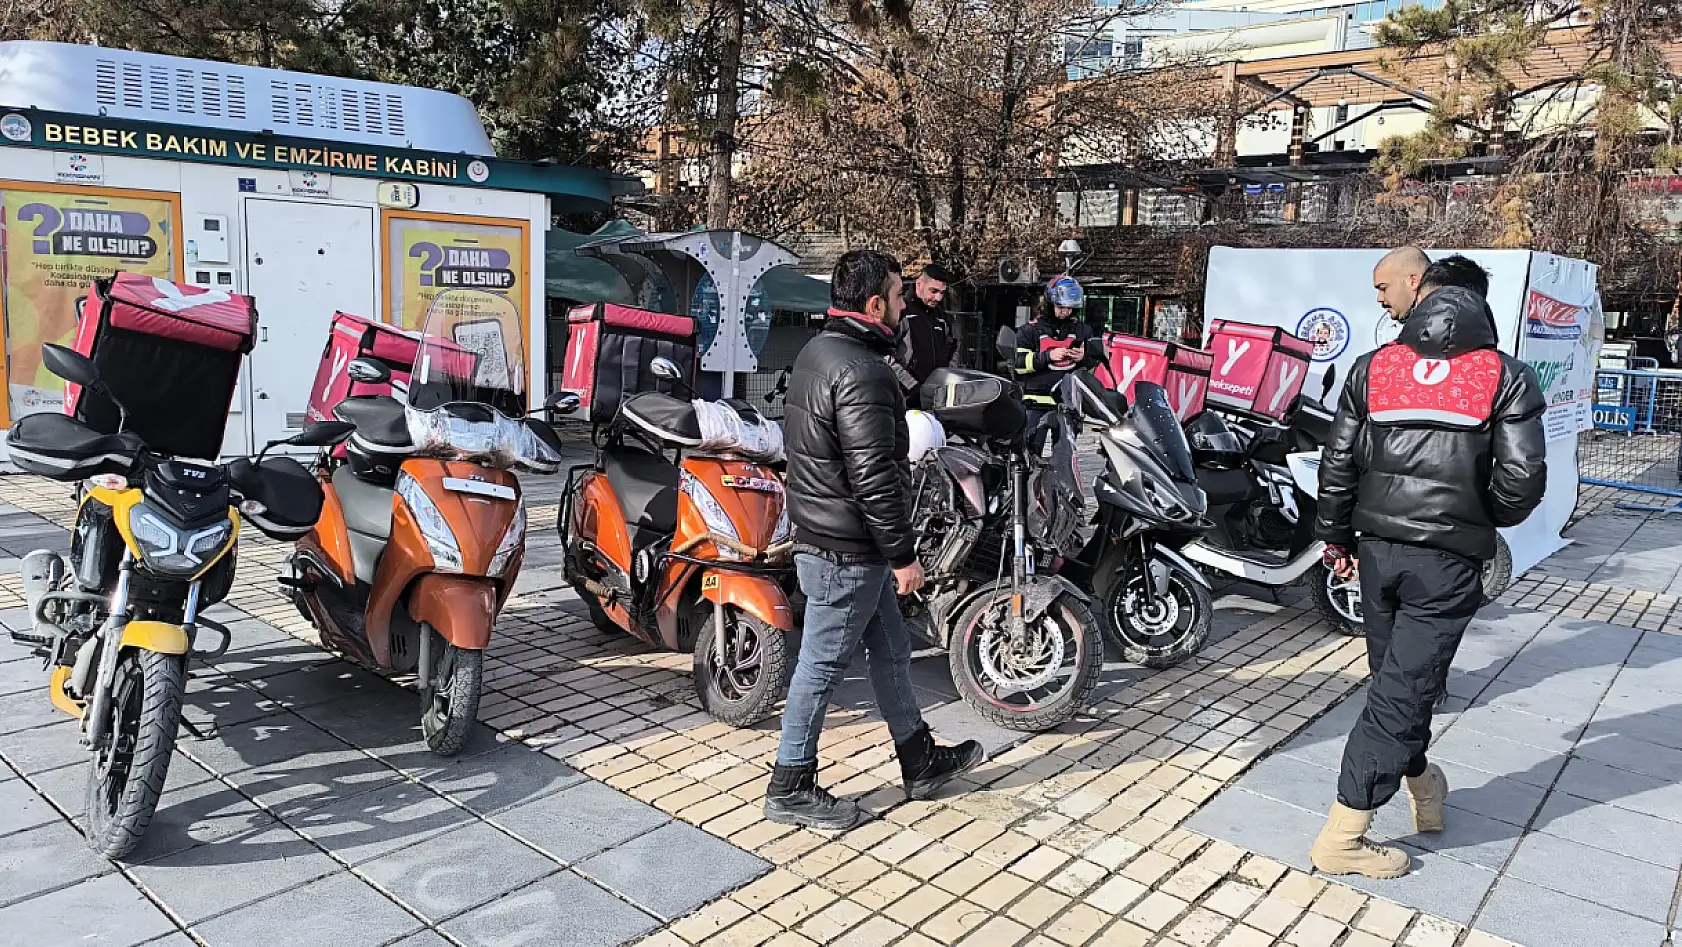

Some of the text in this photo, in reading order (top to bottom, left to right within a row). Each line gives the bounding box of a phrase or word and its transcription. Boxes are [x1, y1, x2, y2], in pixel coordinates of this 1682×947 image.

[45, 123, 138, 149] BEBEK
[146, 133, 228, 157] BAKIM
[235, 141, 267, 161] VE
[274, 146, 378, 172] EMZİRME
[385, 156, 458, 179] KABİNİ
[69, 212, 124, 233] DAHA
[62, 236, 150, 255] NE OLSUN?
[448, 249, 490, 267] DAHA
[441, 270, 511, 286] NE OLSUN?
[1221, 338, 1251, 376] Y
[1423, 360, 1442, 380] Y
[1268, 361, 1299, 412] Y
[1593, 408, 1629, 426] OLİS
[183, 468, 206, 479] TVS
